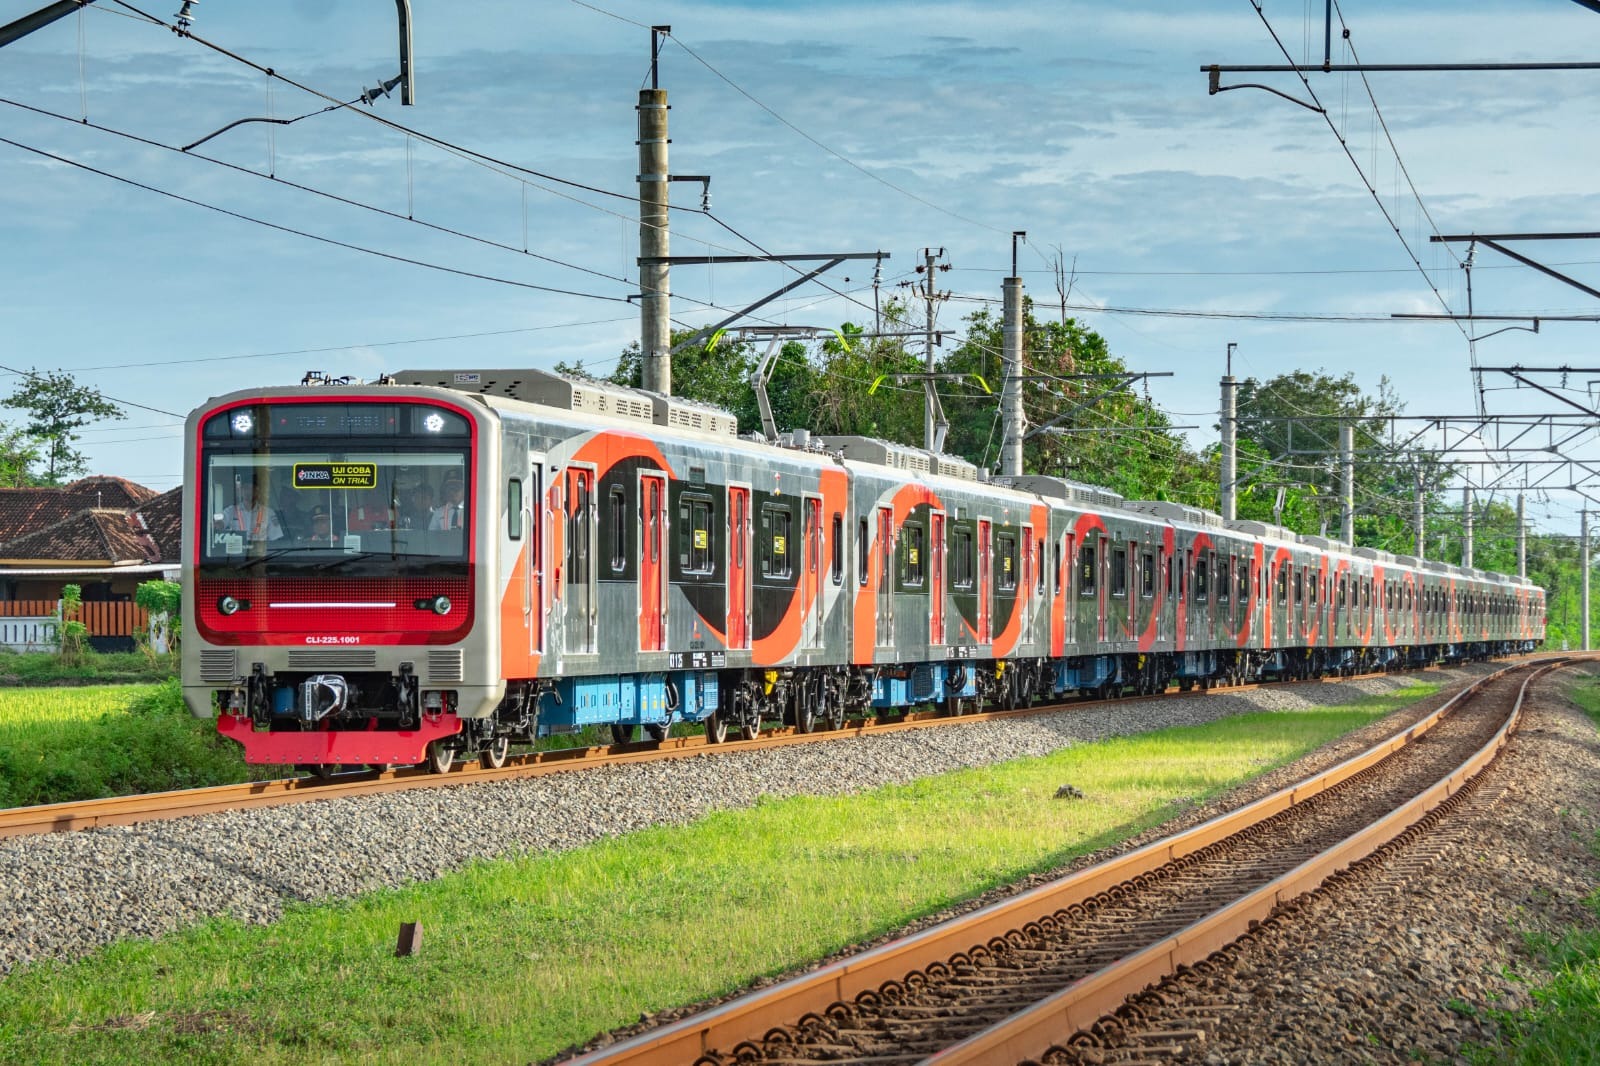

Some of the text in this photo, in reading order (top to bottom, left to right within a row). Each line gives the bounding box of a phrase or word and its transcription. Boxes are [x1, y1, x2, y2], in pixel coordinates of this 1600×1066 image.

[304, 471, 330, 479] INKA
[332, 477, 369, 485] ON TRIAL
[305, 636, 360, 644] CLI-225.1001
